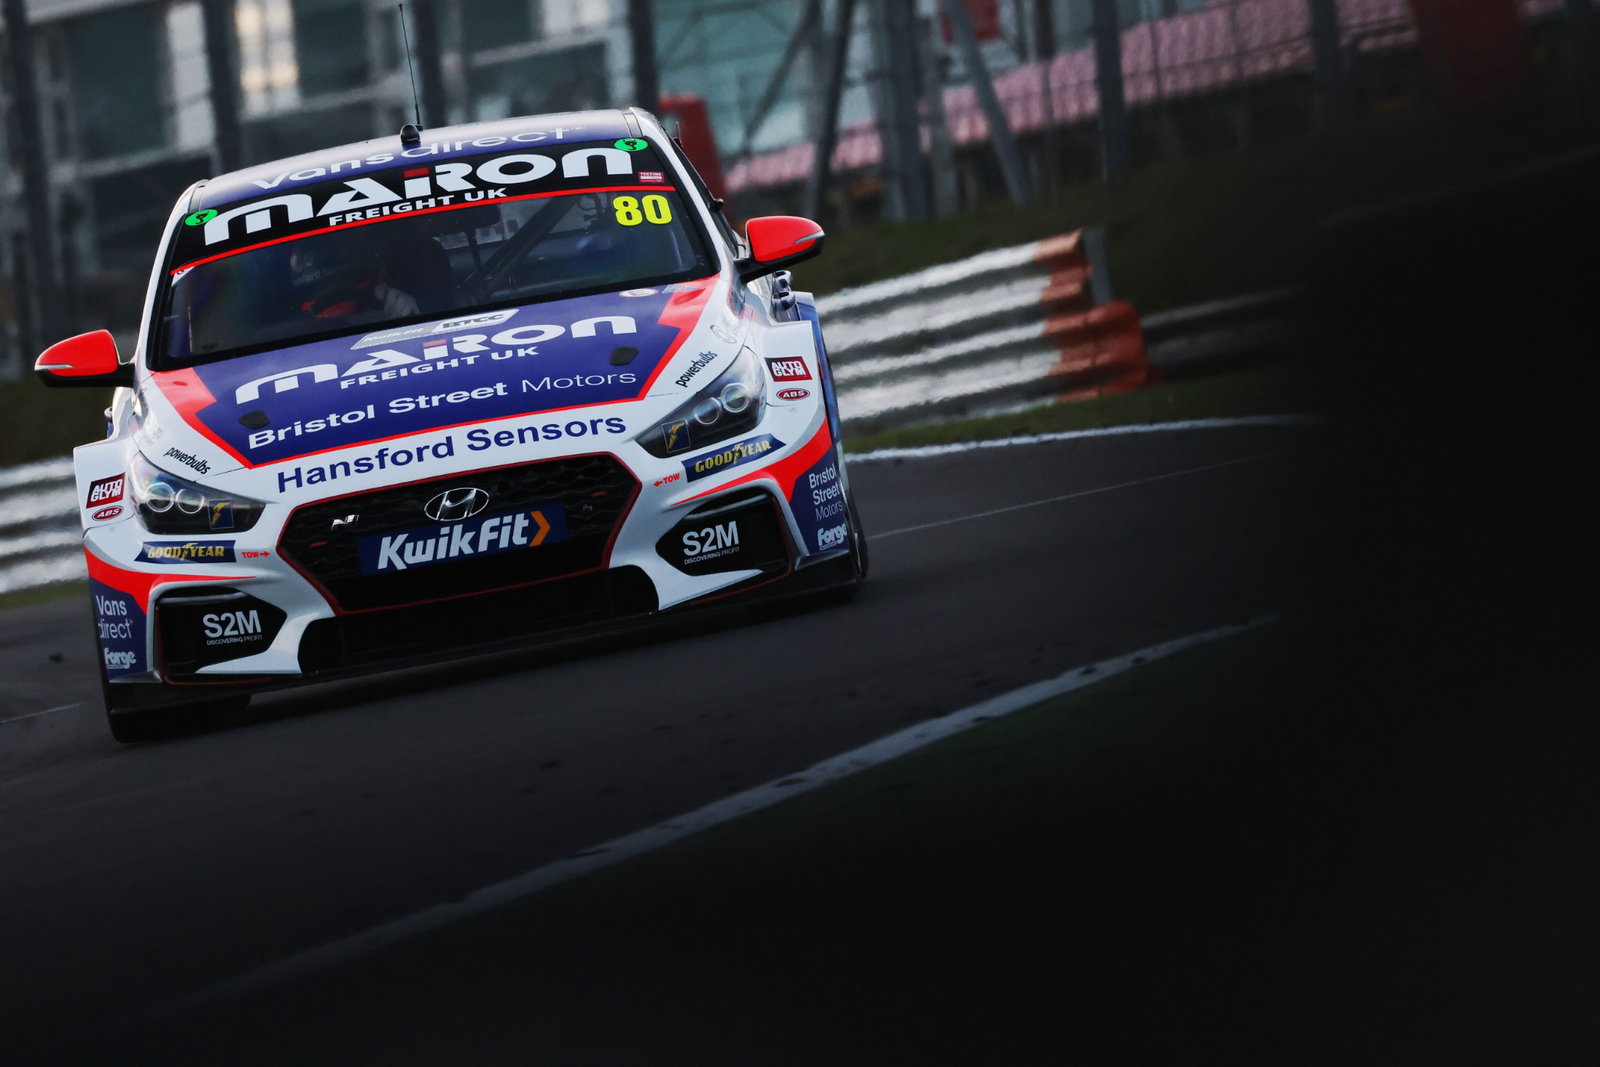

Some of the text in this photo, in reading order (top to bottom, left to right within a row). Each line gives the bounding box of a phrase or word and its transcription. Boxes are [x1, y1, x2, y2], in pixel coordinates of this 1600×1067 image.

[329, 187, 509, 226] FREIGHT UK
[612, 194, 673, 226] 80
[340, 346, 539, 390] FREIGHT UK
[674, 351, 718, 388] powerbulbs
[771, 361, 802, 370] AUTO
[772, 367, 807, 377] GLYM
[783, 390, 805, 398] ABS
[248, 372, 637, 450] Bristol Street Motors
[163, 447, 211, 475] powerbulbs
[277, 416, 627, 494] Hansford Sensors
[94, 479, 123, 492] AUTO
[662, 473, 681, 484] TOW
[808, 463, 837, 489] Bristol
[90, 487, 122, 502] GLYM
[812, 481, 841, 506] Street
[97, 508, 120, 518] ABS
[815, 500, 843, 521] Motors
[682, 520, 740, 557] S2M
[241, 551, 260, 559] TOW
[683, 552, 721, 565] DISCOVERING
[95, 595, 128, 616] Vans
[202, 609, 262, 638] S2M
